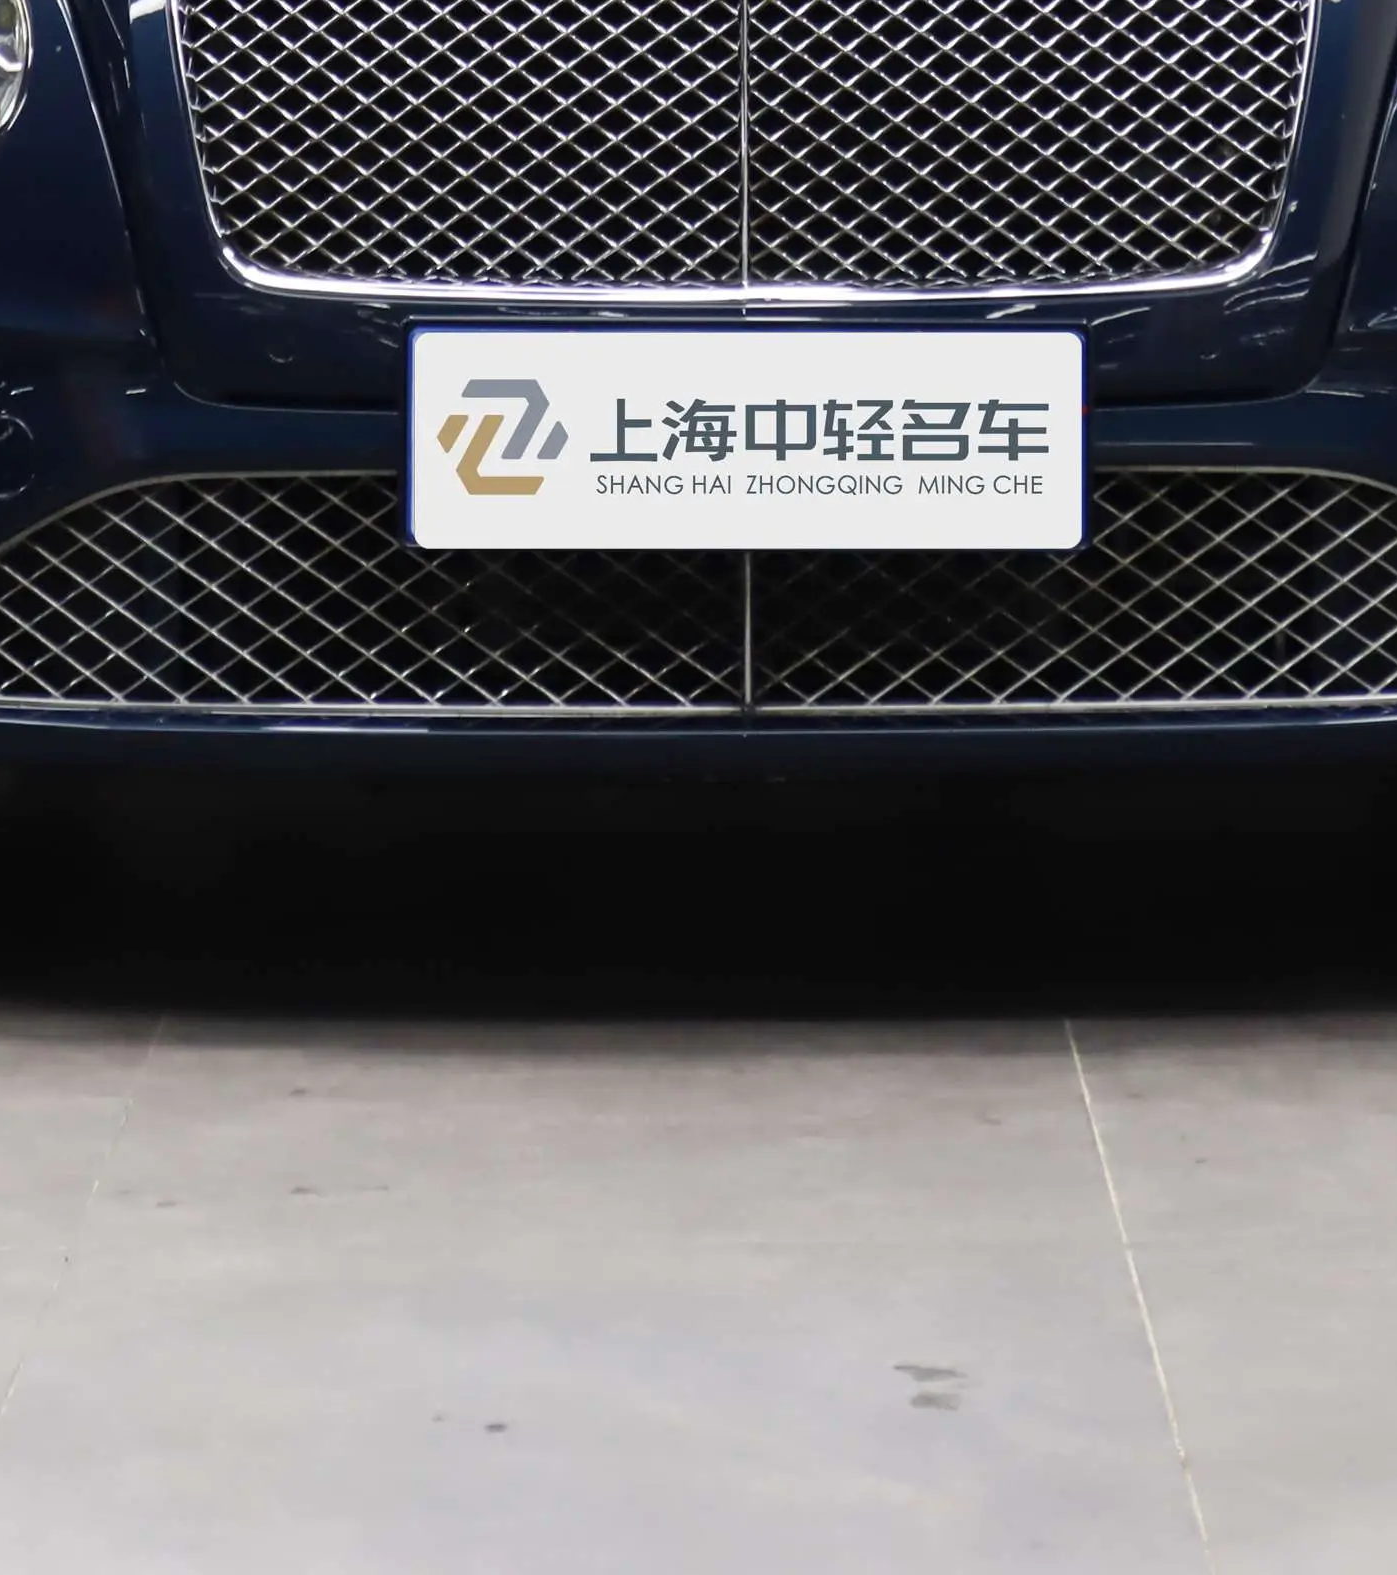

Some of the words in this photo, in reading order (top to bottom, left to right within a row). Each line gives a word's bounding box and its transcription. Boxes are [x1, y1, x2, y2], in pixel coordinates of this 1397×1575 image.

[589, 398, 1049, 462] 上海中轻名车
[595, 474, 684, 496] SHANG
[692, 474, 732, 496] HAI
[746, 474, 903, 497] ZHONGQING
[918, 474, 985, 496] MING
[993, 474, 1043, 496] CHE
